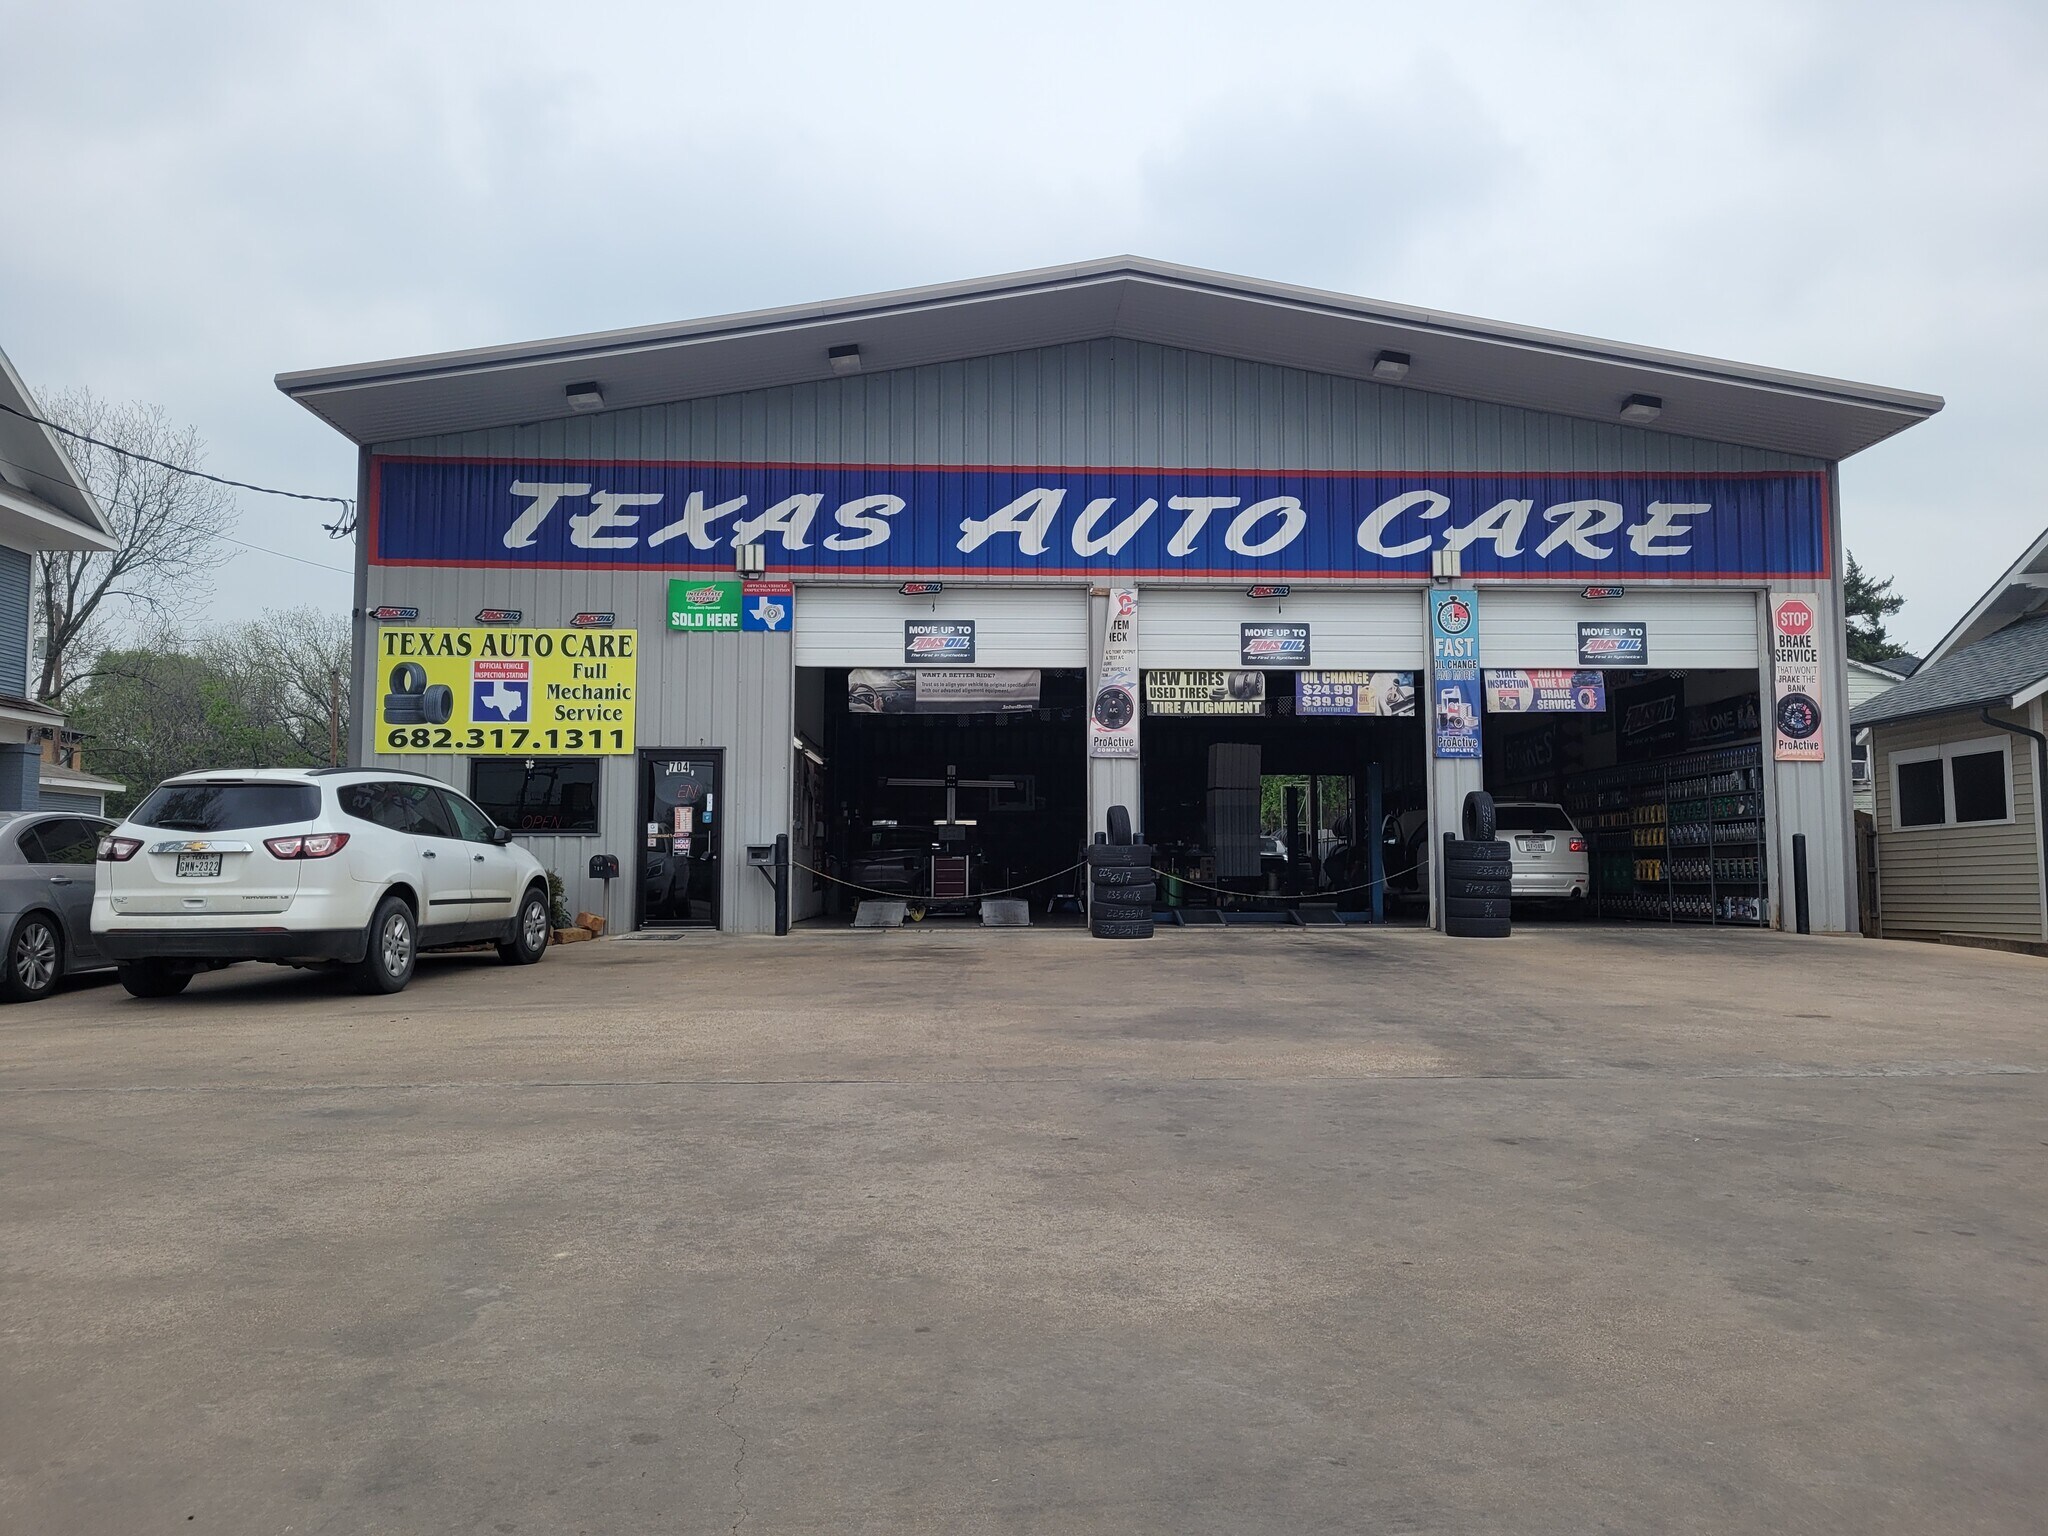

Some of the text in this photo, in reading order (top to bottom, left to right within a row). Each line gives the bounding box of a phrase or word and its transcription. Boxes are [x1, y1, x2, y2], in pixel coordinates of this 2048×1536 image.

[503, 479, 1711, 559] TEXAS AUTO CARE
[901, 583, 942, 594] AMSOIL
[1249, 586, 1289, 597] AMSOIL
[1582, 587, 1623, 598] AMSOIL
[375, 606, 419, 620] AMSOIL
[479, 609, 521, 623] AMSOIL
[1448, 613, 1460, 622] 15
[573, 613, 615, 626] AMSOIL
[672, 612, 738, 627] SOLD HERE
[1111, 620, 1130, 630] TEM
[1781, 612, 1808, 627] STOP
[909, 626, 971, 634] MOVE UP TO
[1244, 629, 1306, 637] MOVE UP TO
[1582, 628, 1643, 636] MOVE UP TO
[383, 632, 633, 658] TEXAS AUTO CARE
[907, 636, 970, 652] AMSOIL
[1243, 639, 1305, 654] AMSOIL
[1580, 638, 1642, 653] AMSOIL
[1779, 635, 1811, 648] BRAKE
[1436, 638, 1474, 657] FAST
[1775, 649, 1817, 662] SERVICE
[479, 662, 523, 670] OFFICIAL VEHICLE
[1448, 660, 1477, 669] CHANGE
[1777, 666, 1817, 674] THAT WON'T
[474, 671, 528, 679] INSPECTION STATION
[573, 663, 607, 679] Full
[1436, 670, 1475, 680] AND MORE
[1496, 670, 1516, 678] STATE
[1538, 670, 1562, 678] AUTO
[1149, 671, 1224, 686] NEW TIRES
[1301, 671, 1370, 684] OIL CHANGE
[1488, 680, 1529, 689] INSPECTION
[1533, 679, 1572, 688] TUNE UP
[547, 684, 631, 700] Mechanic
[1150, 687, 1208, 699] USED TIRES
[1302, 684, 1353, 695] $24.99
[1540, 690, 1571, 699] BRAKE
[1302, 696, 1354, 707] $39.99
[1537, 700, 1576, 710] SERVICE
[555, 705, 622, 721] Service
[1151, 702, 1261, 714] TIRE ALIGNMENT
[388, 729, 623, 749] 682.317.1311
[1094, 737, 1134, 747] ProActive
[1438, 736, 1478, 747] ProActive
[1779, 740, 1819, 750] ProActive
[670, 762, 689, 772] 704
[521, 815, 562, 829] OPEN
